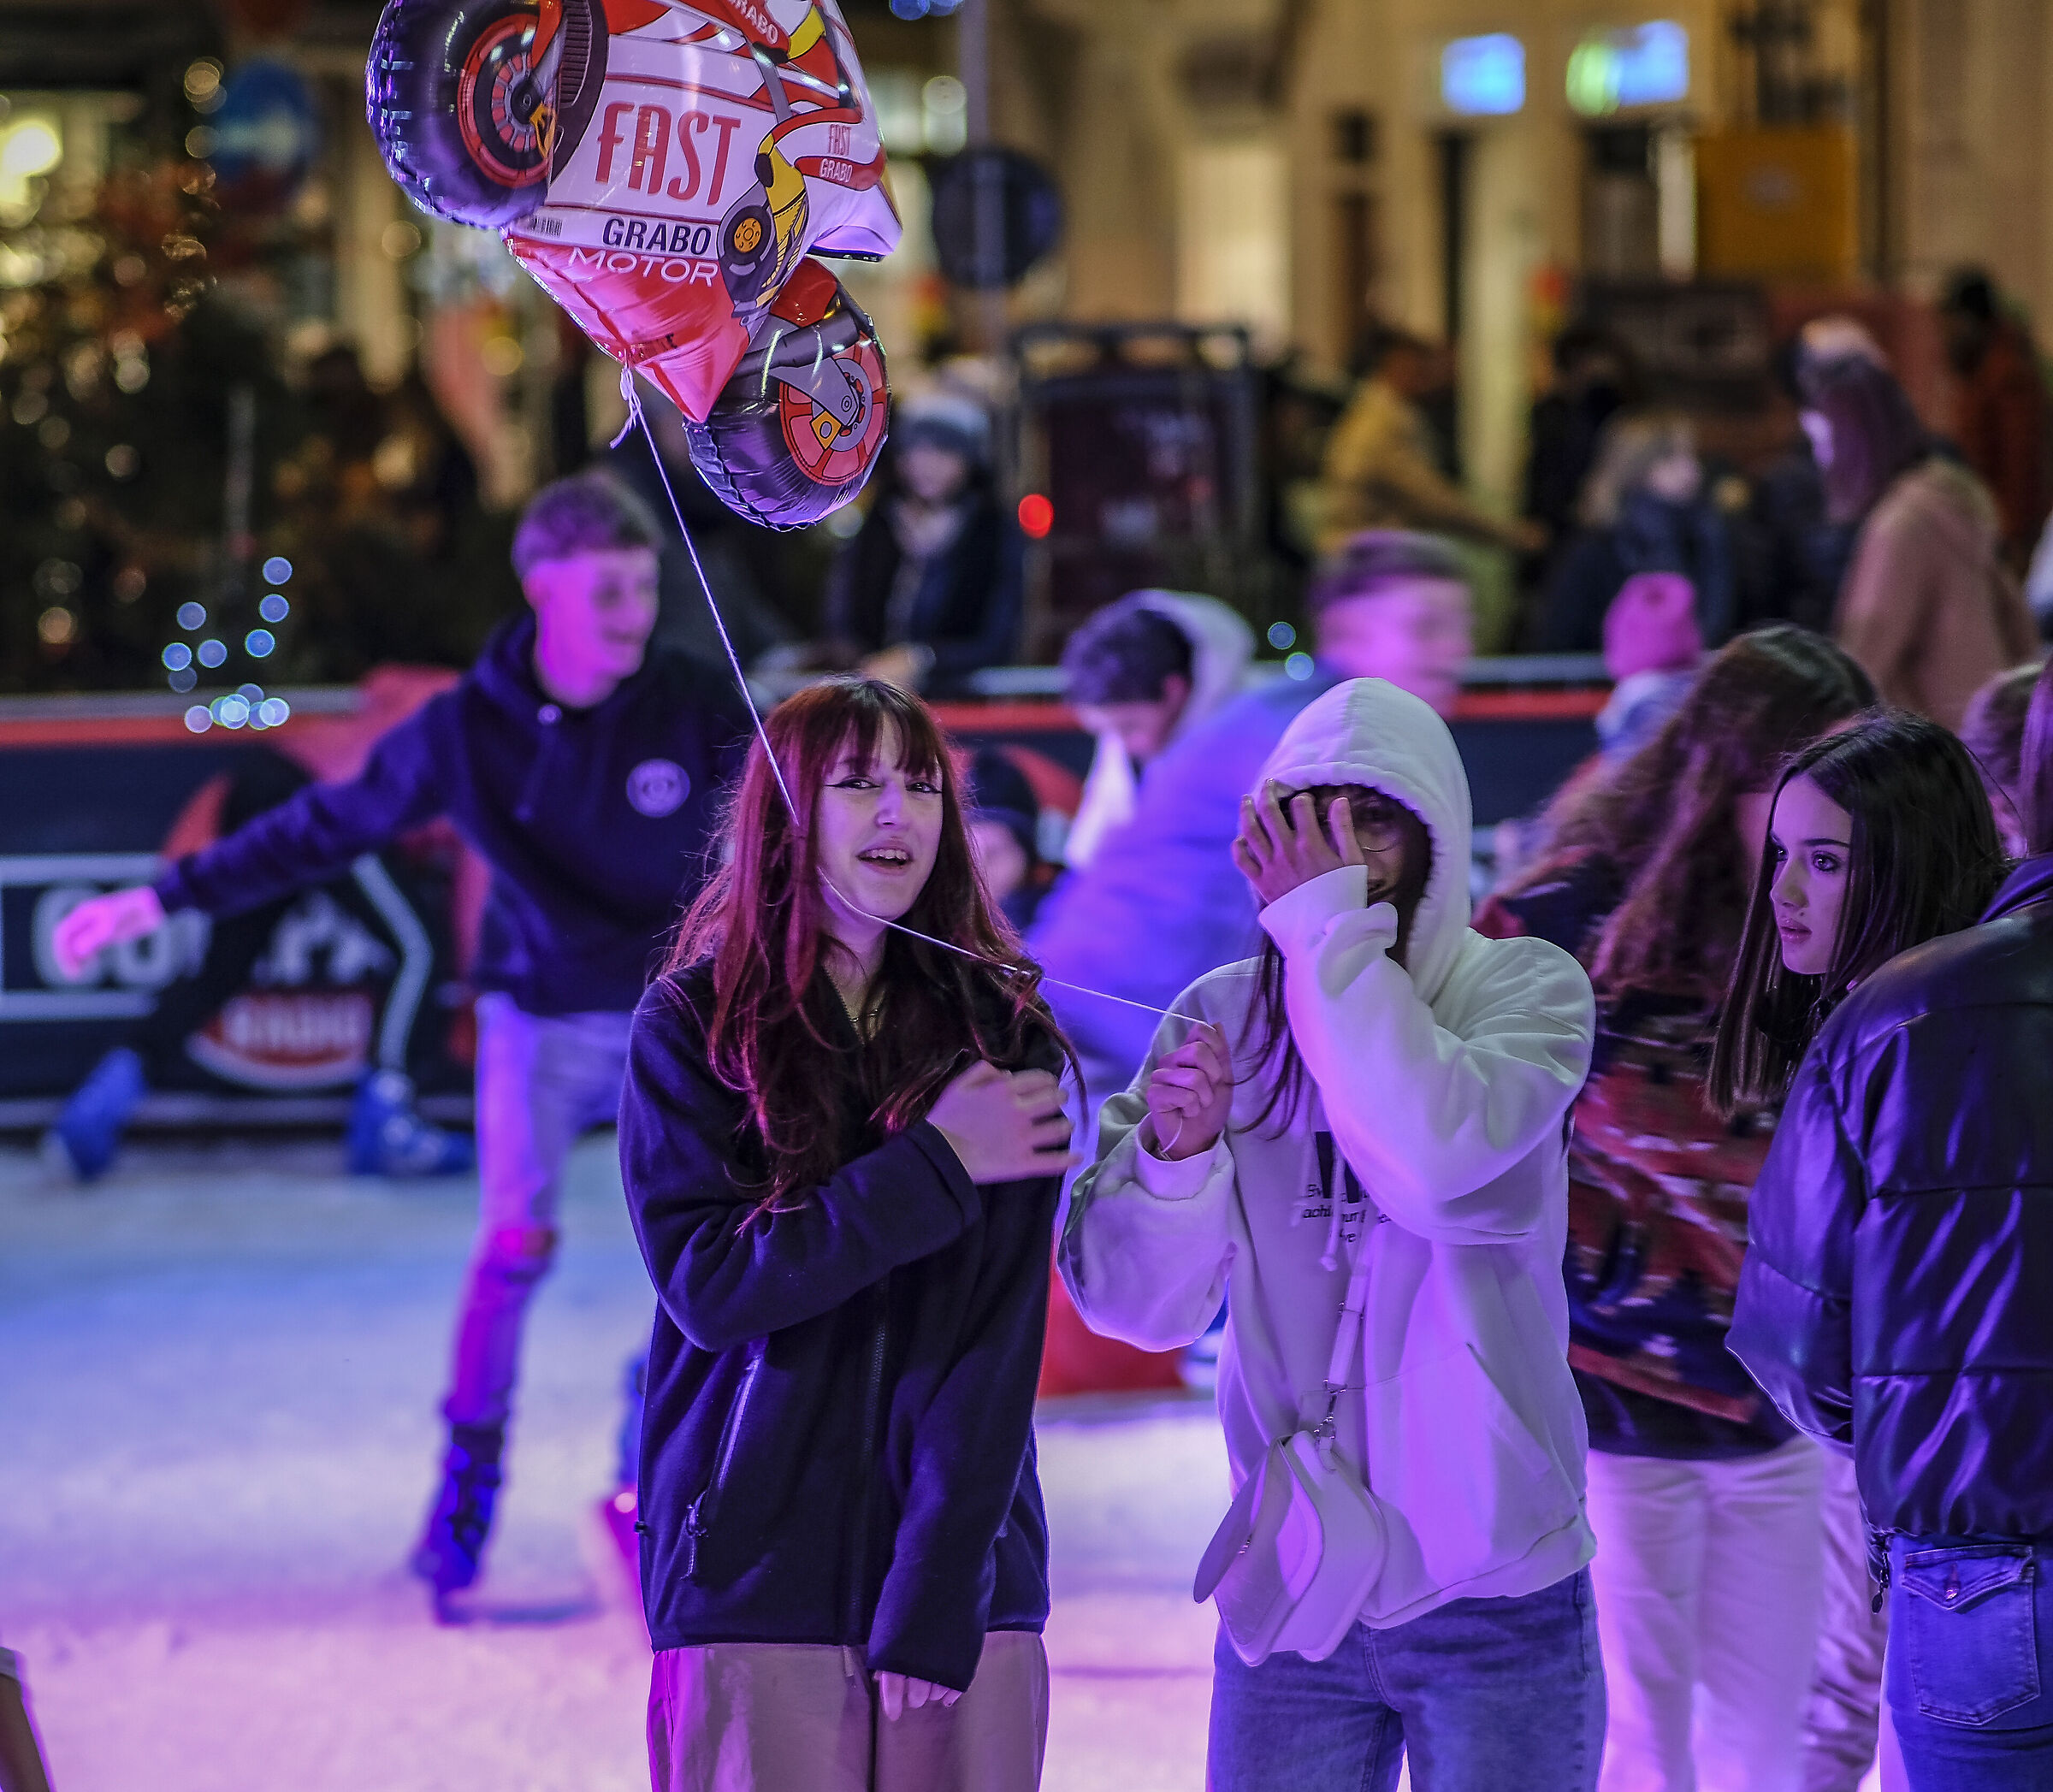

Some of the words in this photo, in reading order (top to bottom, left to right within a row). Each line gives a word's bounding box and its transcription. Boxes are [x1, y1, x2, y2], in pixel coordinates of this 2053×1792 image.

[729, 0, 778, 44] RABO
[595, 100, 742, 206] FAST
[828, 123, 851, 155] FAST
[819, 158, 854, 182] GRABO
[602, 218, 712, 256] GRABO
[568, 246, 719, 287] MOTOR
